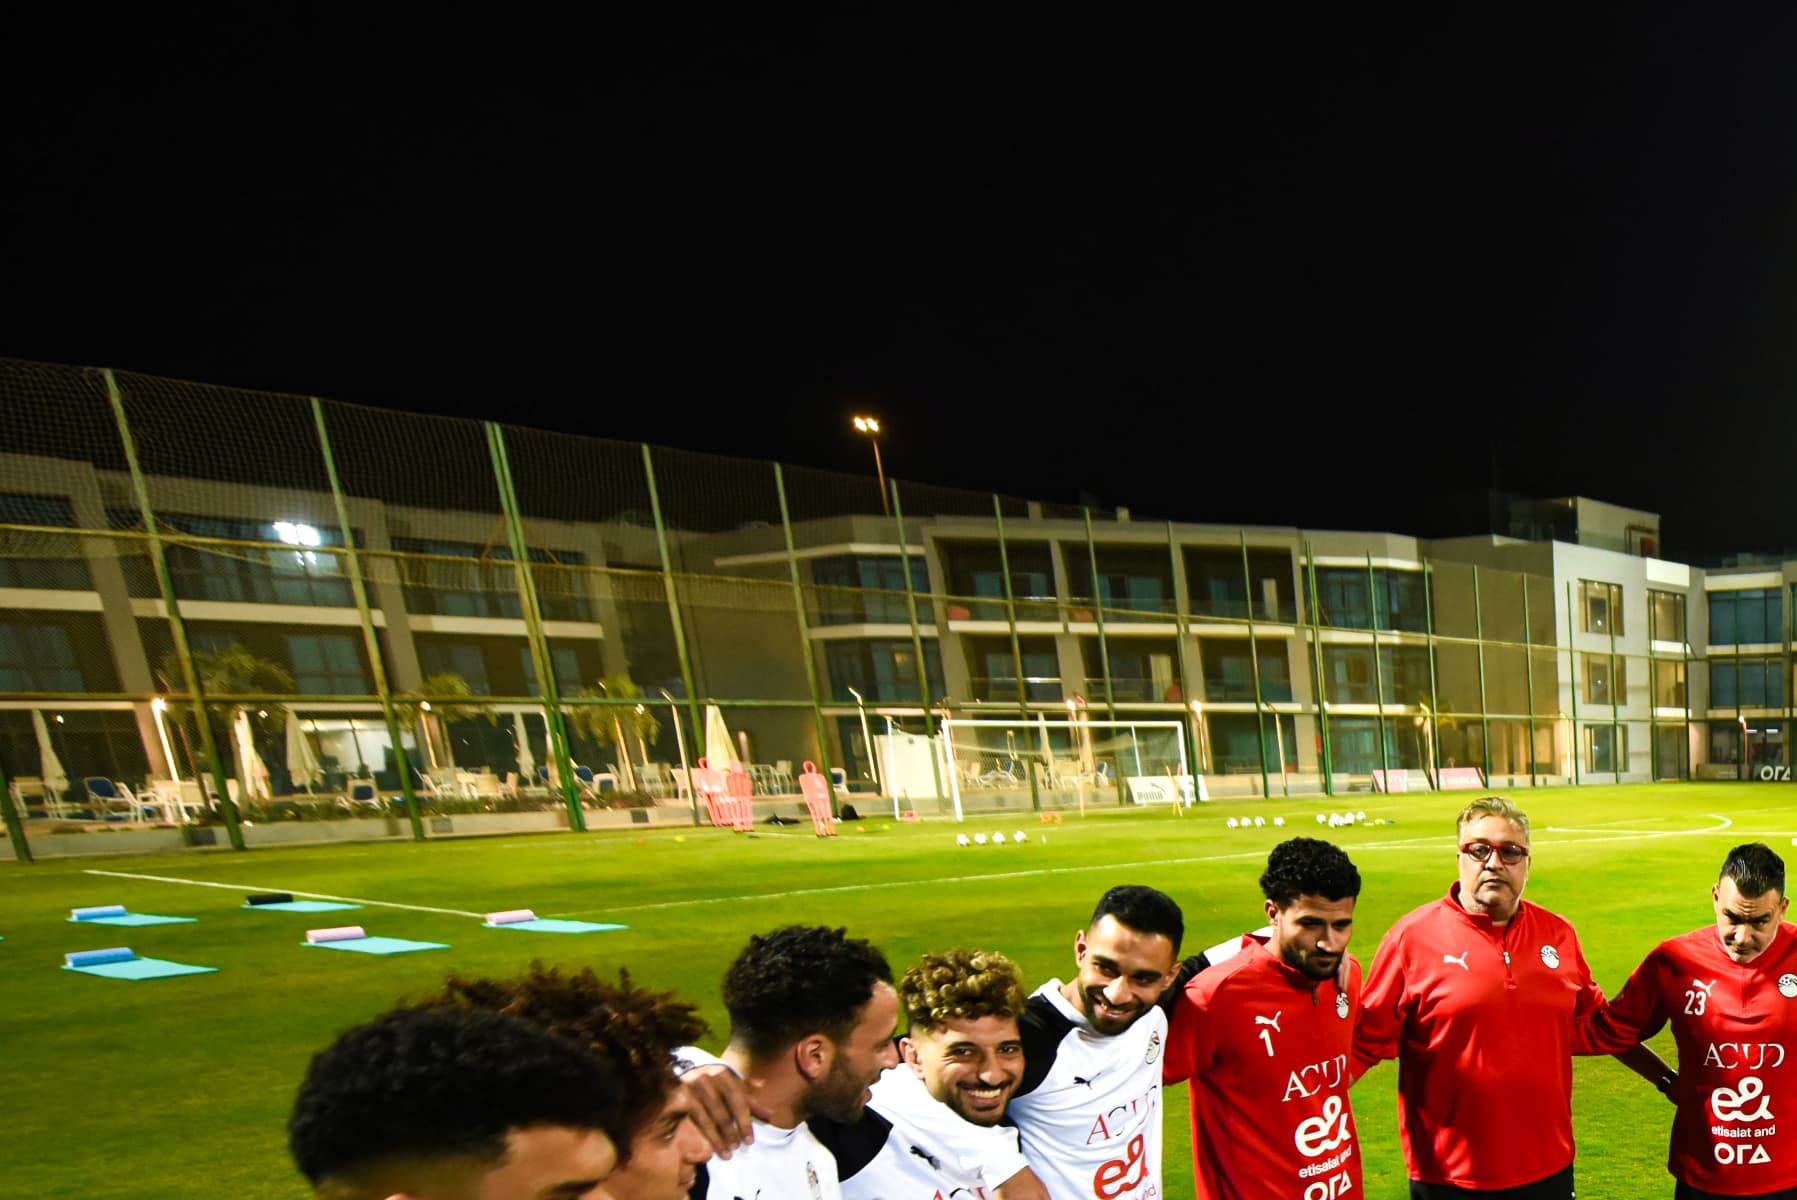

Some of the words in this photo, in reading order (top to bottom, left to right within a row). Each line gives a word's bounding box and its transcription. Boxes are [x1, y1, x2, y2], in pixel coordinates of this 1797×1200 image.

[1684, 990, 1706, 1015] 23
[1259, 1028, 1274, 1057] 1
[1703, 1042, 1785, 1070] ACUD
[1711, 1124, 1752, 1138] etisalat
[1754, 1124, 1776, 1136] and
[1298, 1155, 1340, 1178] etisalat
